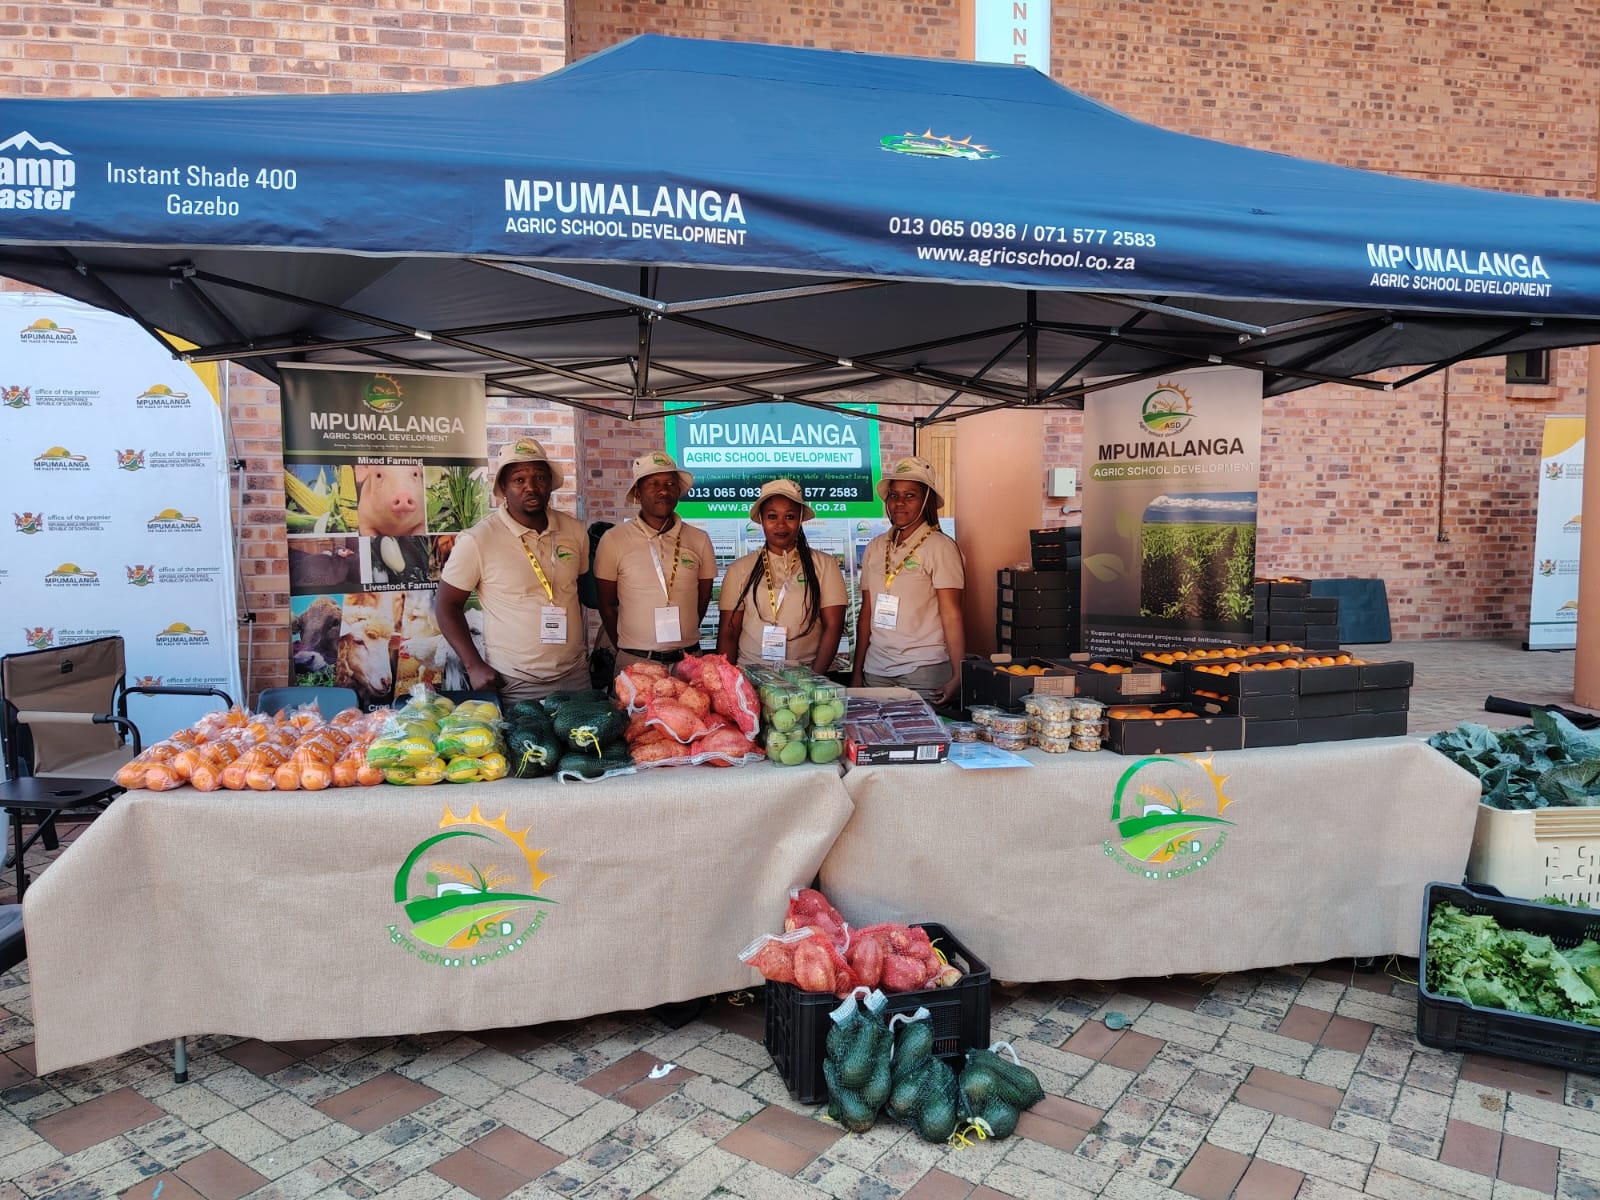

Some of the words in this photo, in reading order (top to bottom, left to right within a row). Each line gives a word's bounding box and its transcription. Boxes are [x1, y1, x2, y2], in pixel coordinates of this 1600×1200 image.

[107, 162, 181, 186] Instant
[186, 165, 250, 188] Shade
[255, 169, 297, 190] 400
[166, 194, 240, 216] Gazebo
[504, 179, 747, 224] MPUMALANGA
[505, 217, 557, 234] AGRIC
[561, 219, 628, 238] SCHOOL
[631, 222, 747, 246] DEVELOPMENT
[889, 217, 924, 236] 013
[930, 219, 964, 238] 065
[970, 221, 1017, 240] 0936
[1034, 225, 1068, 243] 071
[1073, 228, 1107, 245] 577
[1113, 231, 1157, 248] 2583
[917, 245, 1136, 271] www.agricschool.co.za
[1366, 243, 1550, 279] MPUMALANGA
[1370, 272, 1410, 289] AGRIC
[1412, 275, 1463, 292] SCHOOL
[1465, 278, 1552, 297] DEVELOPMENT
[310, 412, 465, 434] MPUMALANGA
[689, 423, 858, 445] MPUMALANGA
[322, 431, 351, 440] AGRIC
[352, 432, 387, 441] SCHOOL
[389, 433, 448, 443] DEVELOPMENT
[686, 452, 721, 463] AGRIC
[724, 451, 771, 463] SCHOOL
[773, 452, 854, 463] DEVELOPMENT
[1098, 437, 1244, 461] MPUMALANGA
[358, 456, 385, 465] Mixed
[387, 456, 424, 467] Farming
[1093, 466, 1125, 477] AGRIC
[1127, 465, 1171, 476] SCHOOL
[1173, 462, 1256, 475] DEVELOPMENT
[688, 487, 710, 497] 013
[714, 487, 736, 497] 065
[739, 487, 761, 497] 093
[804, 487, 826, 497] 577
[829, 487, 858, 497] 2583
[363, 583, 406, 592] Livestock
[408, 582, 439, 590] Farmin
[1155, 634, 1182, 642] projects
[1165, 839, 1201, 856] ASD
[385, 924, 417, 953] Agric
[417, 950, 465, 968] school
[470, 909, 549, 968] development
[467, 921, 515, 941] ASD
